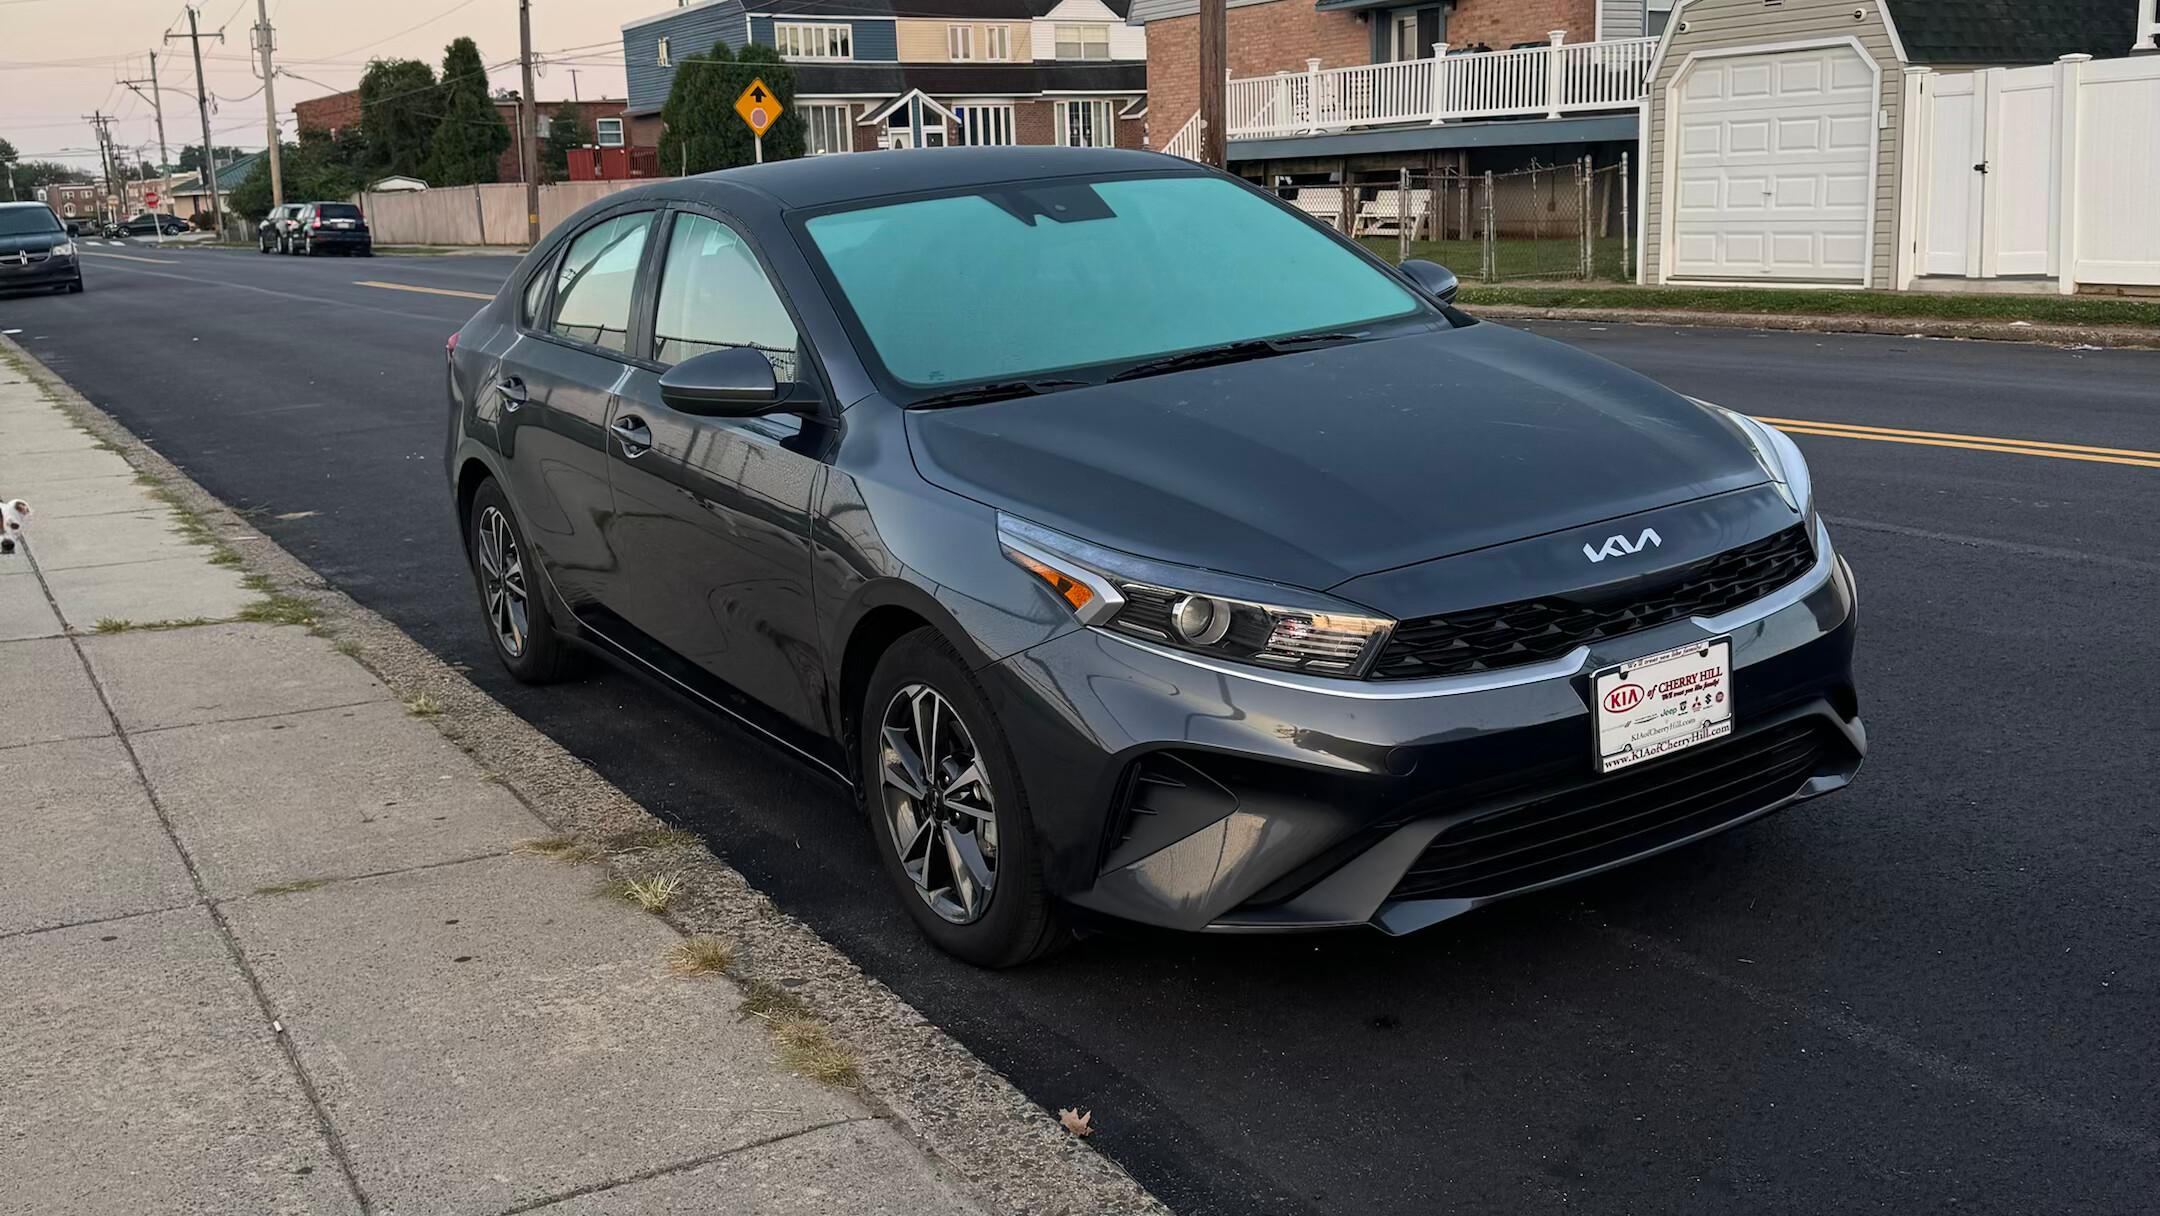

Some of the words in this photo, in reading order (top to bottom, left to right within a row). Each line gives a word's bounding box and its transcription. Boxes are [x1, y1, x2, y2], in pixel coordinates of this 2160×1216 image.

[1583, 527, 1662, 563] KIA
[1611, 689, 1638, 709] KIA
[1647, 683, 1658, 699] of
[1658, 672, 1698, 693] CHERRY
[1700, 666, 1723, 682] HILL
[1631, 718, 1696, 742] KIAofCherryHill.com
[1660, 707, 1677, 717] Jeep
[1604, 724, 1730, 768] www.KIAofCherryHill.com
